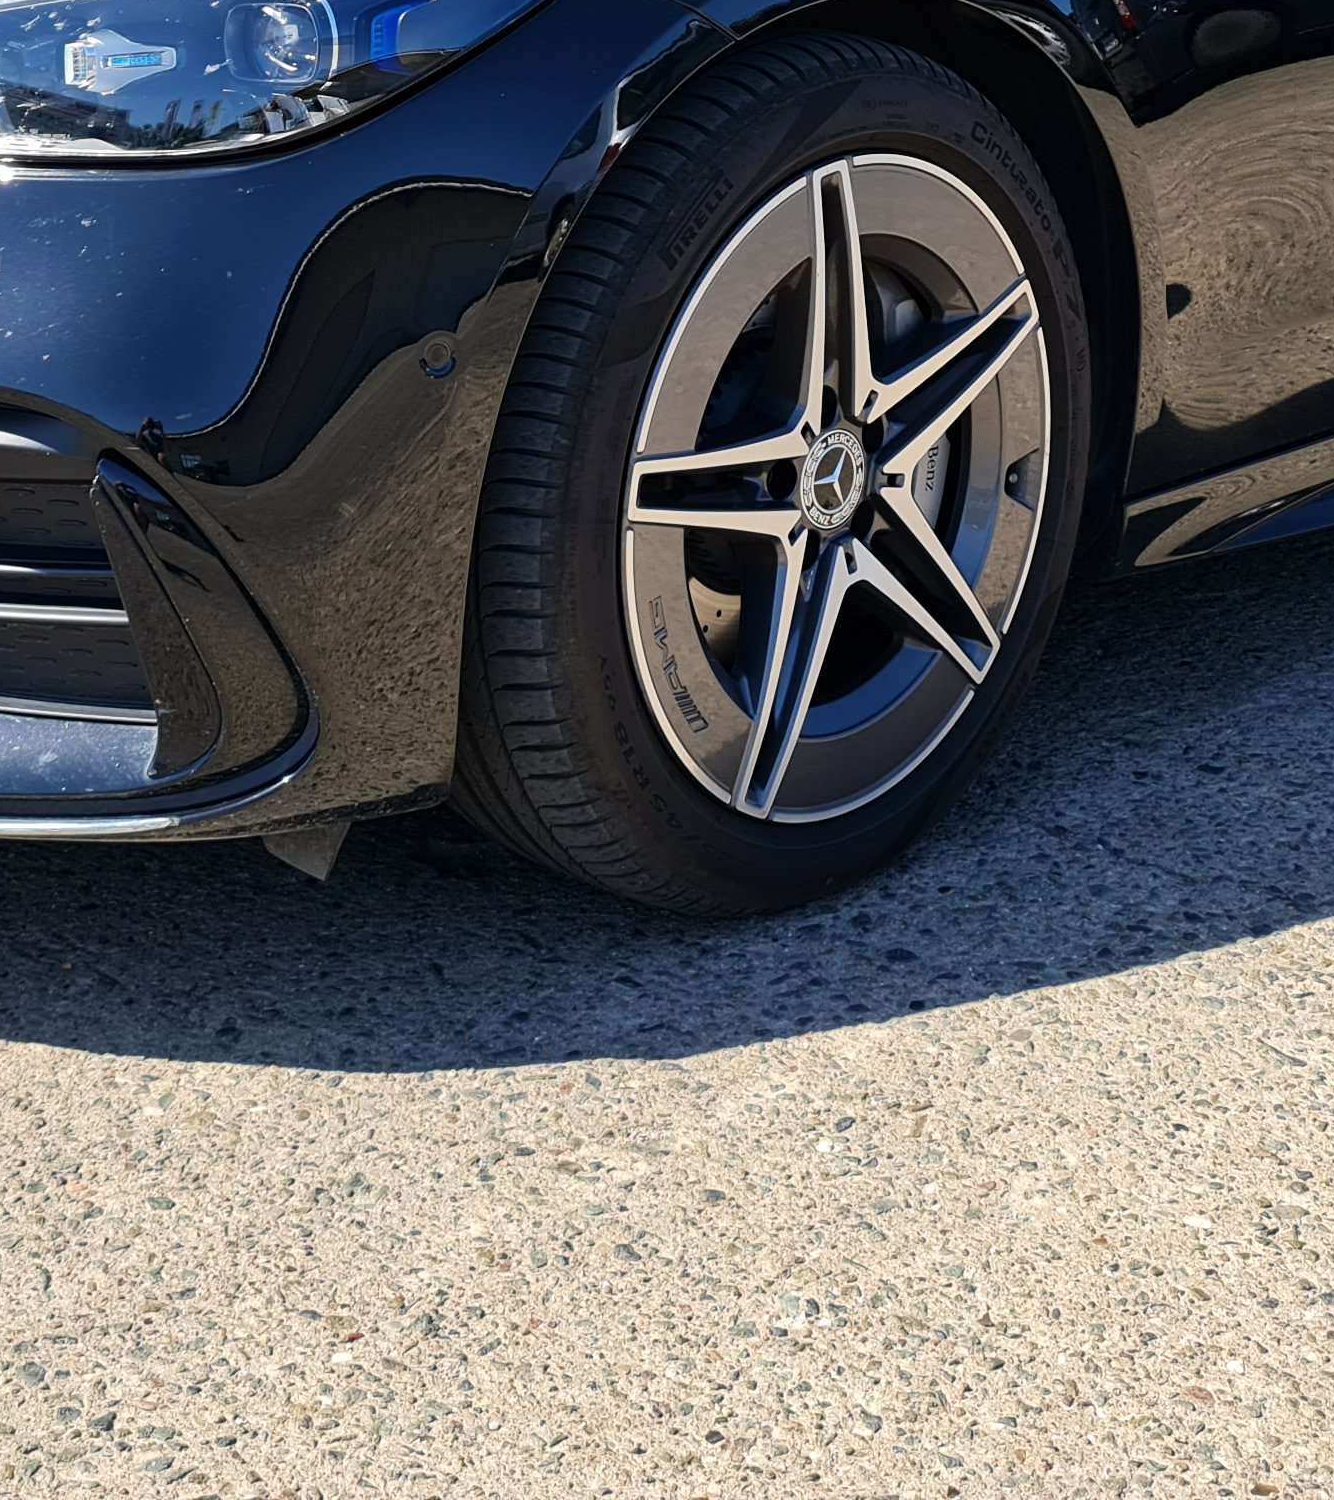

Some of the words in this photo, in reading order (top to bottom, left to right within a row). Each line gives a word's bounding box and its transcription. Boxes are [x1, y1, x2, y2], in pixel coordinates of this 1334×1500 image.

[969, 118, 1055, 237] Cinturato
[827, 433, 863, 466] MERCEDES
[926, 446, 939, 492] Benz
[809, 506, 832, 525] BENZ
